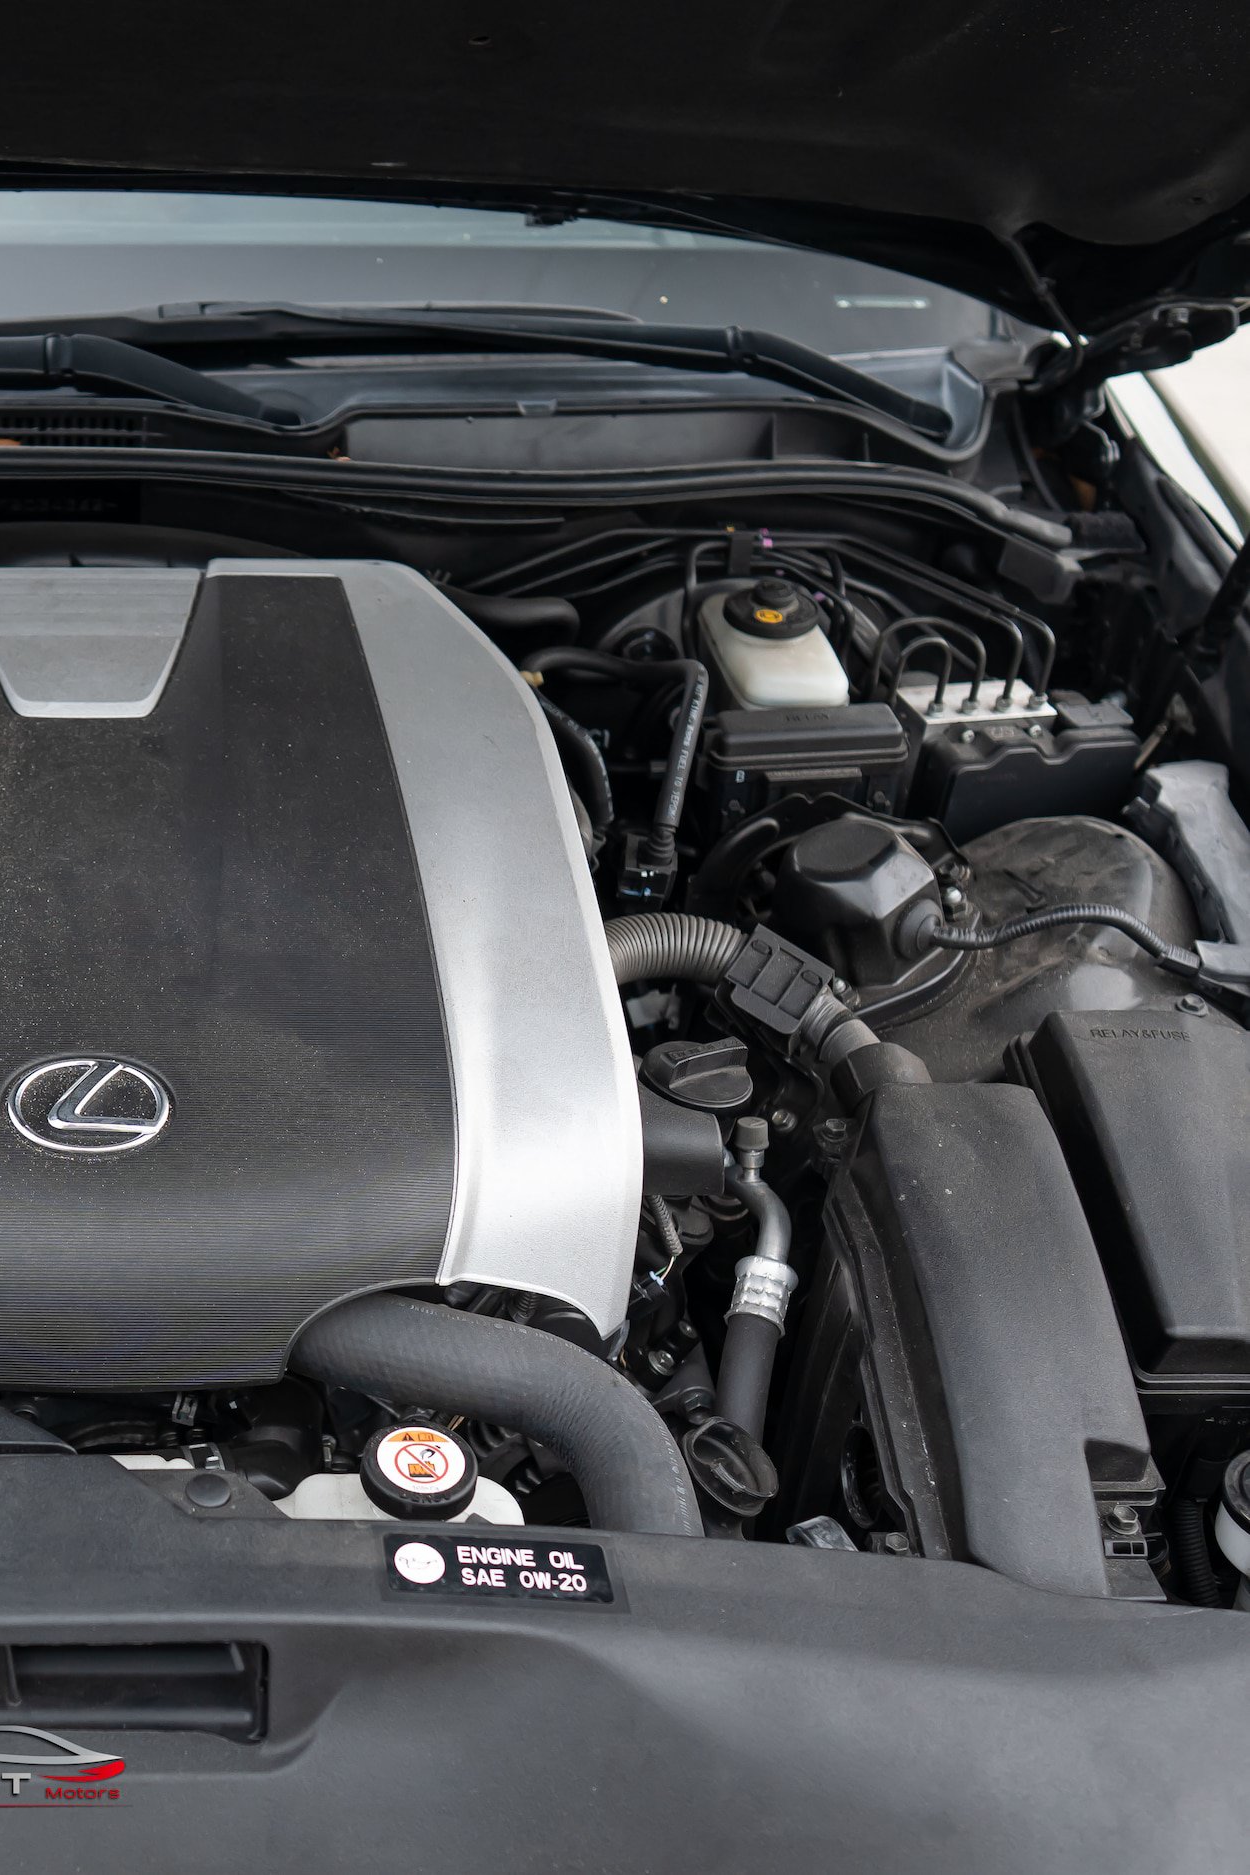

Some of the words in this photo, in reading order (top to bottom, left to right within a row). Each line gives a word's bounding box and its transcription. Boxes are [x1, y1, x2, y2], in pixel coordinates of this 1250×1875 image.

[1089, 1029, 1191, 1042] RELAY&FUSE
[456, 1545, 536, 1567] ENGINE
[548, 1551, 584, 1570] OIL
[461, 1568, 506, 1587] SAE
[519, 1571, 587, 1592] 0W-20
